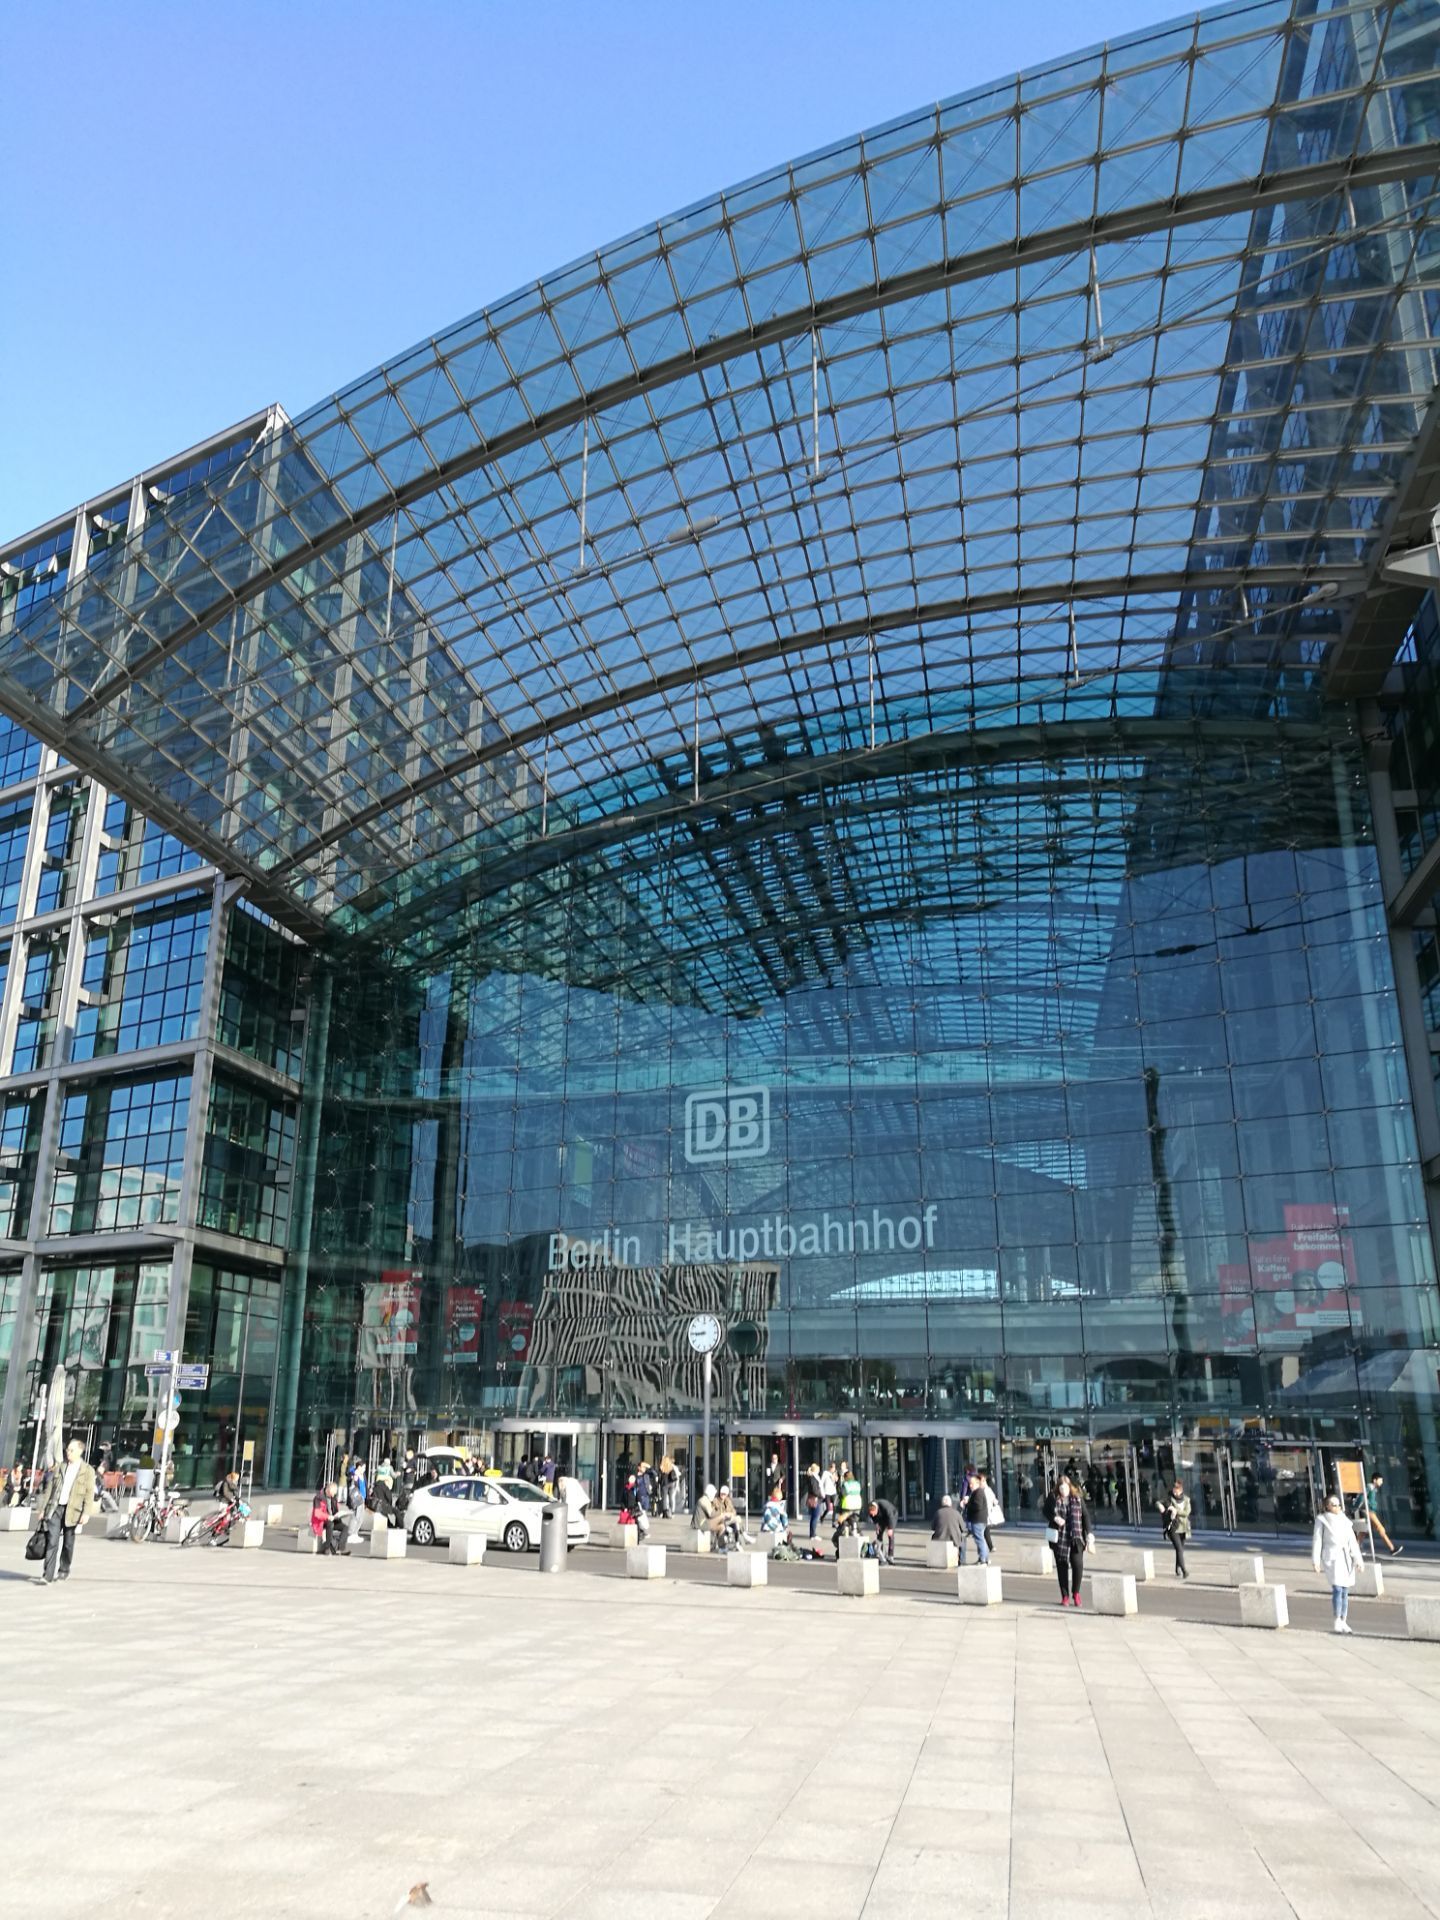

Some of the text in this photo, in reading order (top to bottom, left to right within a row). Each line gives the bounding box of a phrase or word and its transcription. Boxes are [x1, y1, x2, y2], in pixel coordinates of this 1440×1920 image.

[694, 1096, 762, 1153] DB
[548, 1204, 938, 1271] Berlin Hauptbahnhof
[1034, 1425, 1073, 1439] KATER
